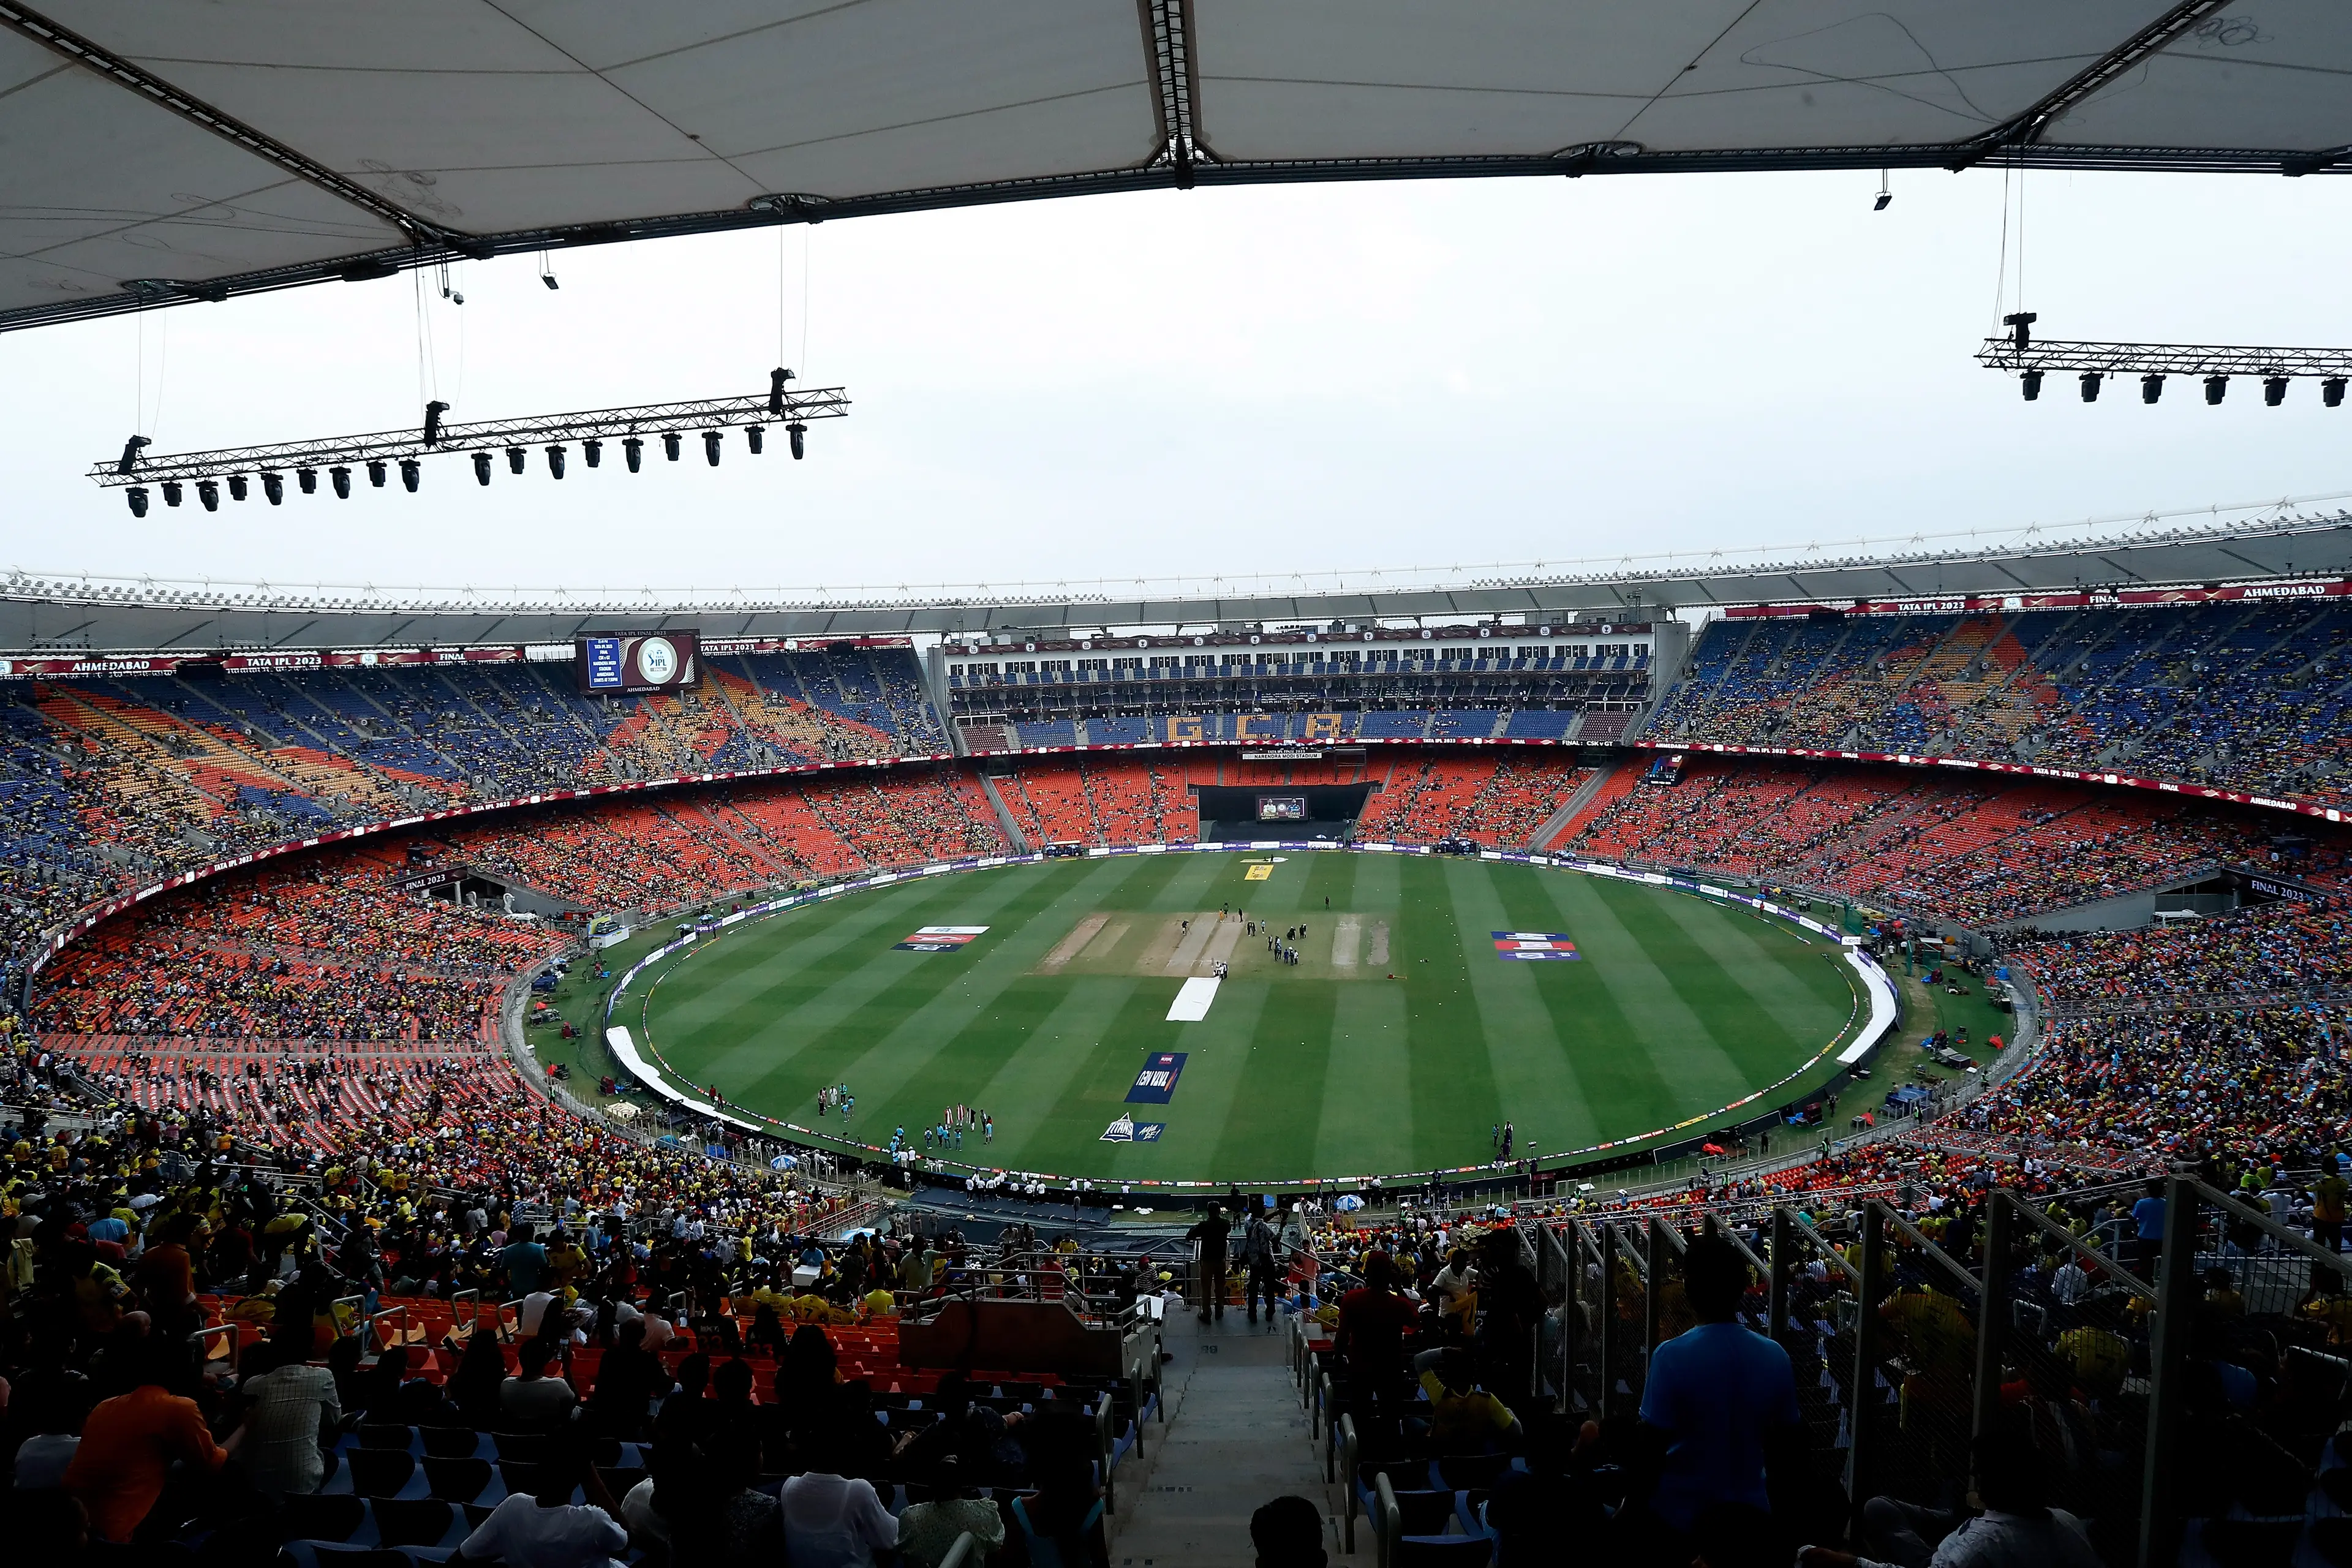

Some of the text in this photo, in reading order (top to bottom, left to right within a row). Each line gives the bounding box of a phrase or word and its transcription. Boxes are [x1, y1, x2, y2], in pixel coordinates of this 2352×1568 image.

[2242, 586, 2325, 597] AHMEDABAD
[2089, 595, 2120, 604] FINAL
[72, 661, 150, 671] AHMEDABAD
[246, 658, 272, 666] TATA
[1937, 758, 1979, 767] AHMEDABAD
[644, 778, 679, 787] AHMEDABAD
[2159, 783, 2179, 792] FINAL
[470, 804, 484, 813] TATA
[2250, 796, 2297, 810] AHMEDABAD
[389, 815, 425, 827] AHMEDABAD
[303, 838, 319, 848] FINAL
[214, 854, 253, 872] TATA IPL 2023
[405, 874, 446, 890] FINAL 2023
[135, 883, 164, 902] AHMEDABAD
[2252, 880, 2304, 902] FINAL 2023
[1136, 1070, 1170, 1087] TATA NEU
[1106, 1122, 1134, 1135] TITANS
